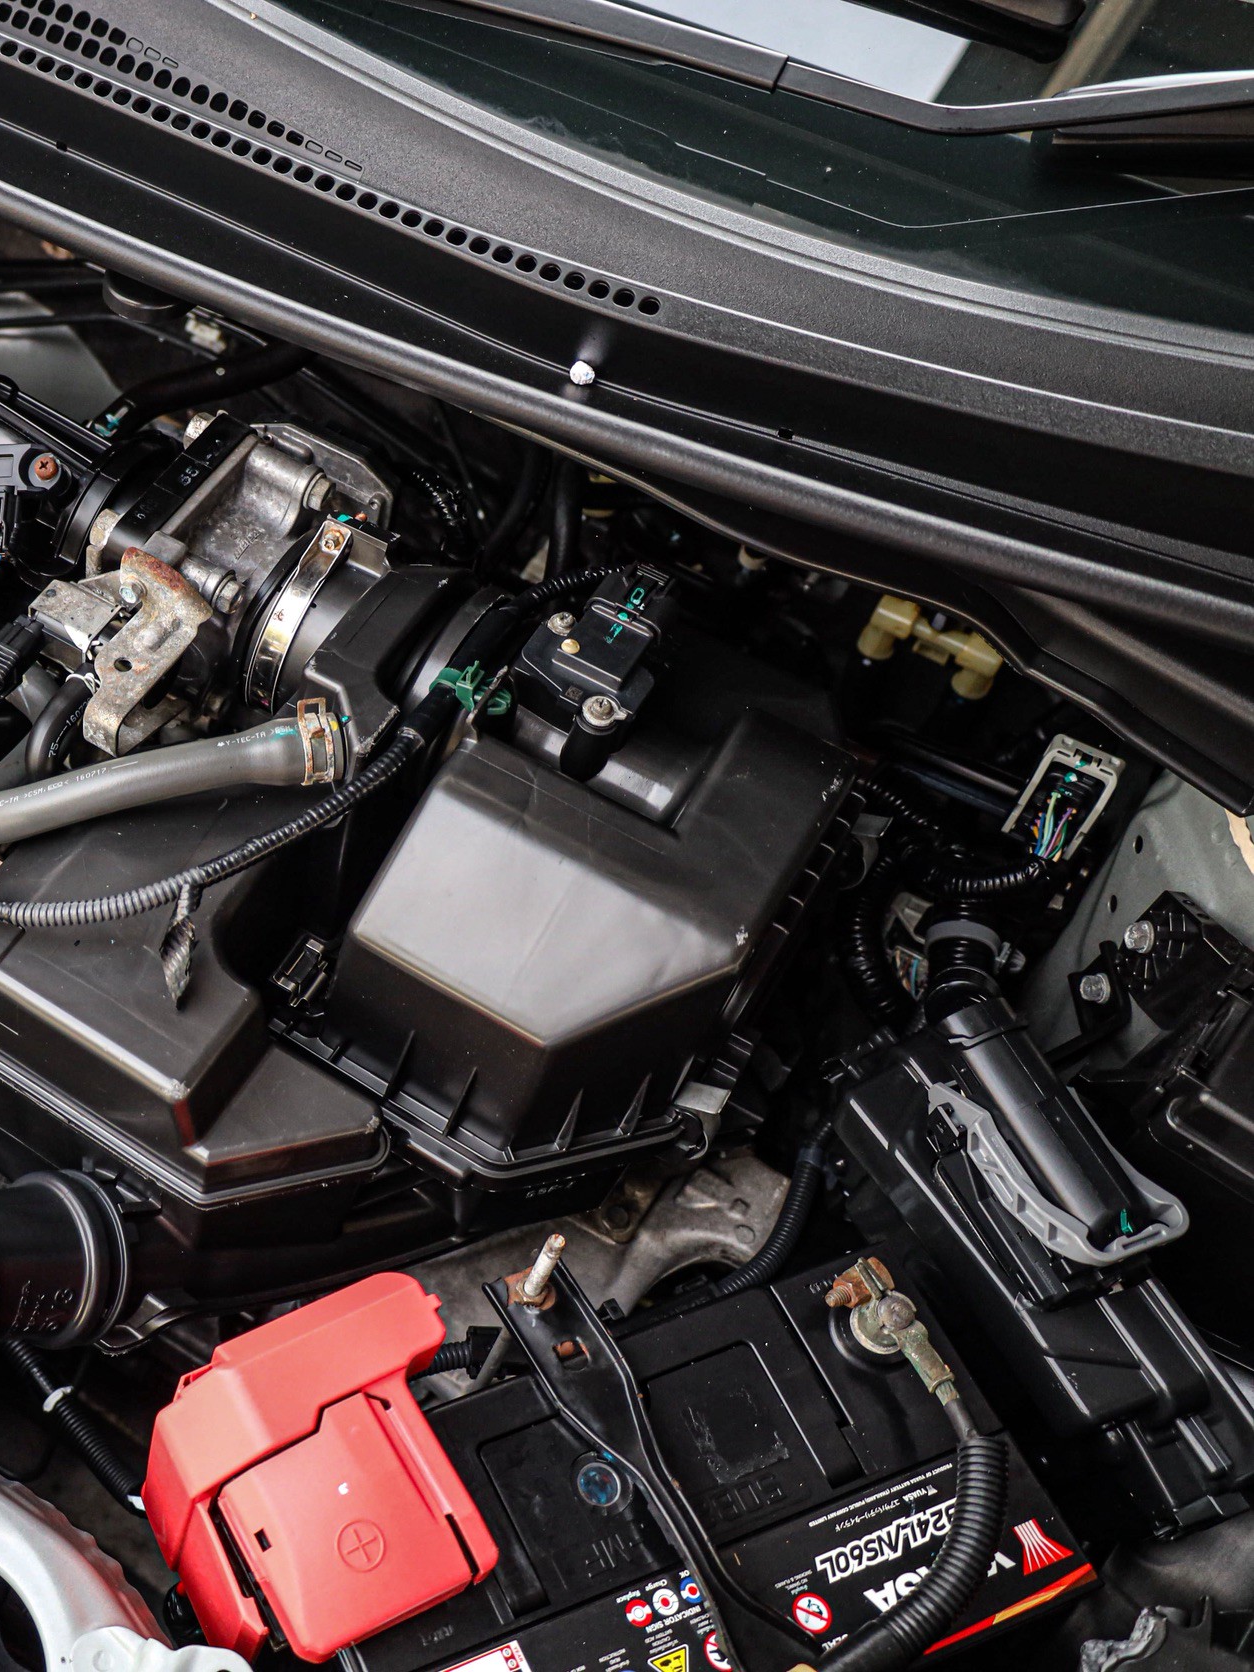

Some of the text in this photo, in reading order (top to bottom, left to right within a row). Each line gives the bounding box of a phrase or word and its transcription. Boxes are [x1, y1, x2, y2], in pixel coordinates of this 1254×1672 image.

[931, 1462, 952, 1475] PRODUCT
[889, 1480, 910, 1492] BATTERY
[901, 1487, 927, 1502] YUASA
[848, 1499, 865, 1510] PUBLIC
[807, 1515, 827, 1527] LIMITED
[678, 1569, 690, 1578] OK
[644, 1577, 667, 1592] Charge
[614, 1588, 641, 1604] Replace
[644, 1604, 701, 1633] INDICATOR SIGN
